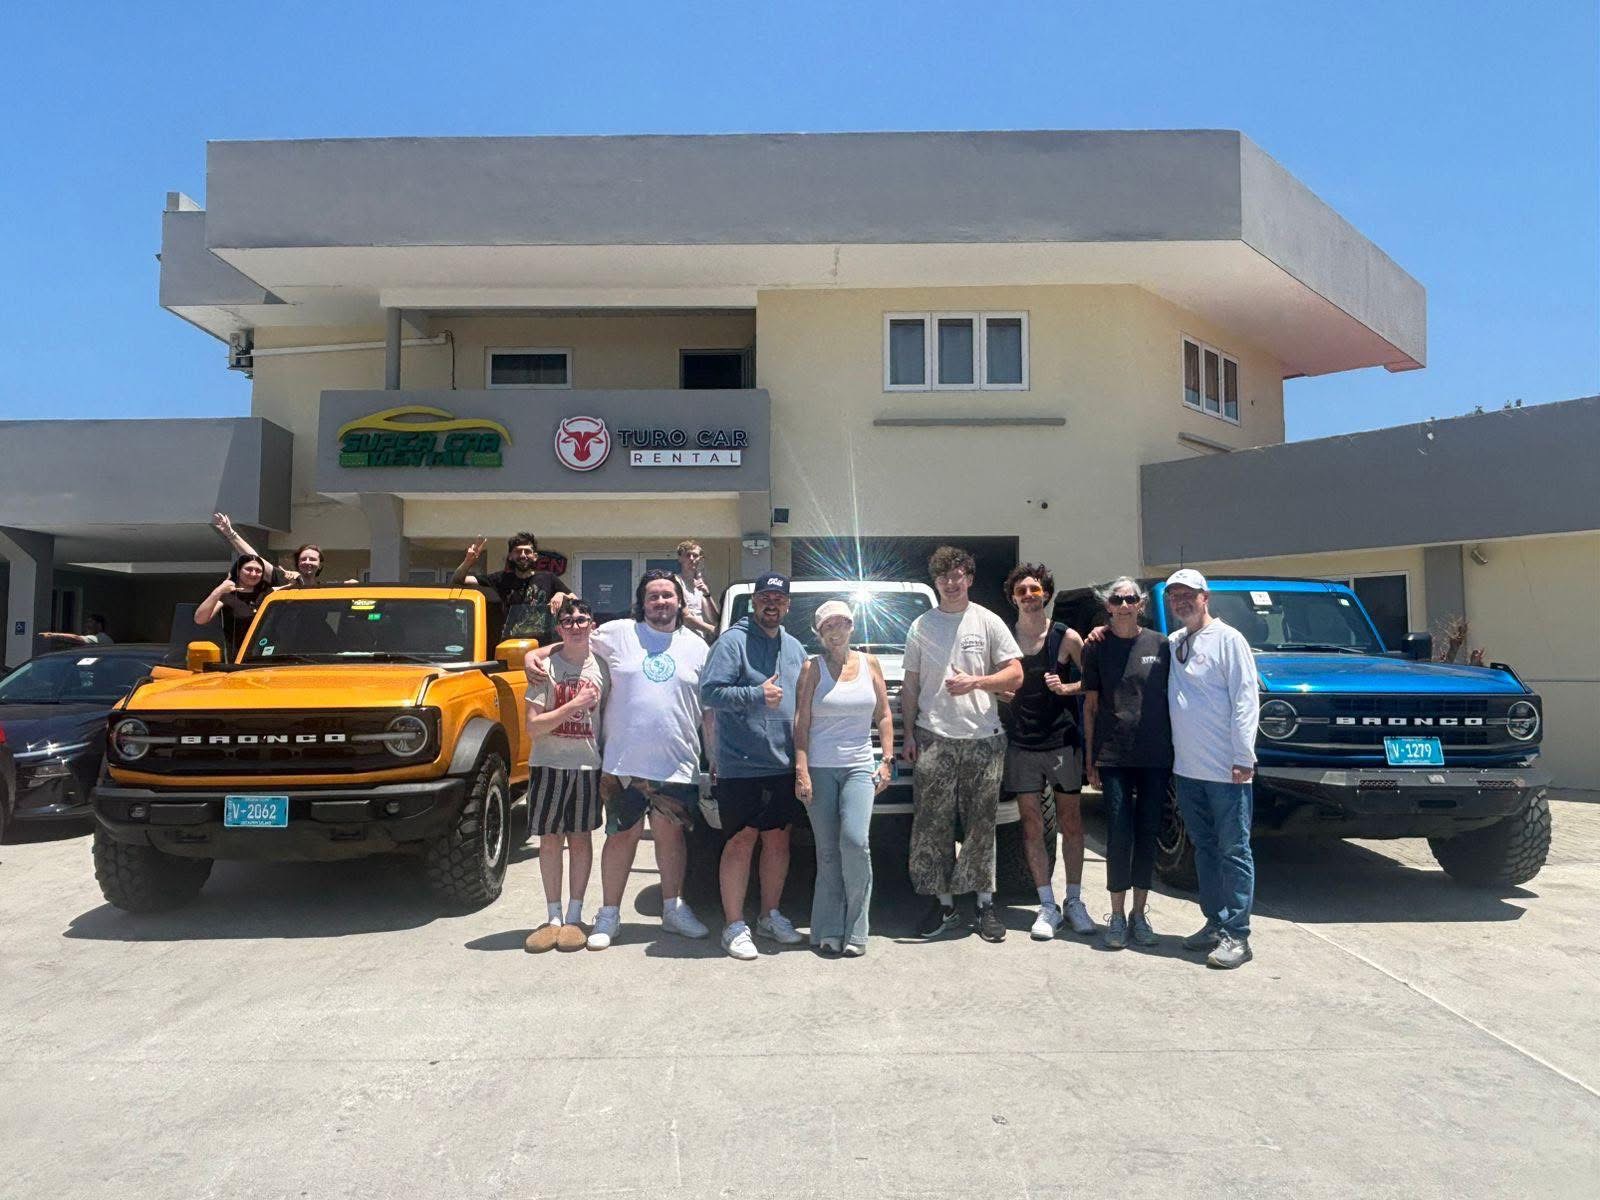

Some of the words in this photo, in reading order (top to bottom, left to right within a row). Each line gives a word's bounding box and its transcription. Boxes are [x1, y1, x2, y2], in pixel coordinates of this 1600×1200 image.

[617, 429, 688, 448] TURO
[696, 429, 748, 448] CAR
[633, 453, 738, 463] RENTAL
[1336, 717, 1483, 725] BRONCO
[181, 734, 346, 744] BRONCO
[1392, 743, 1432, 758] V-1279
[232, 803, 277, 820] V-2062
